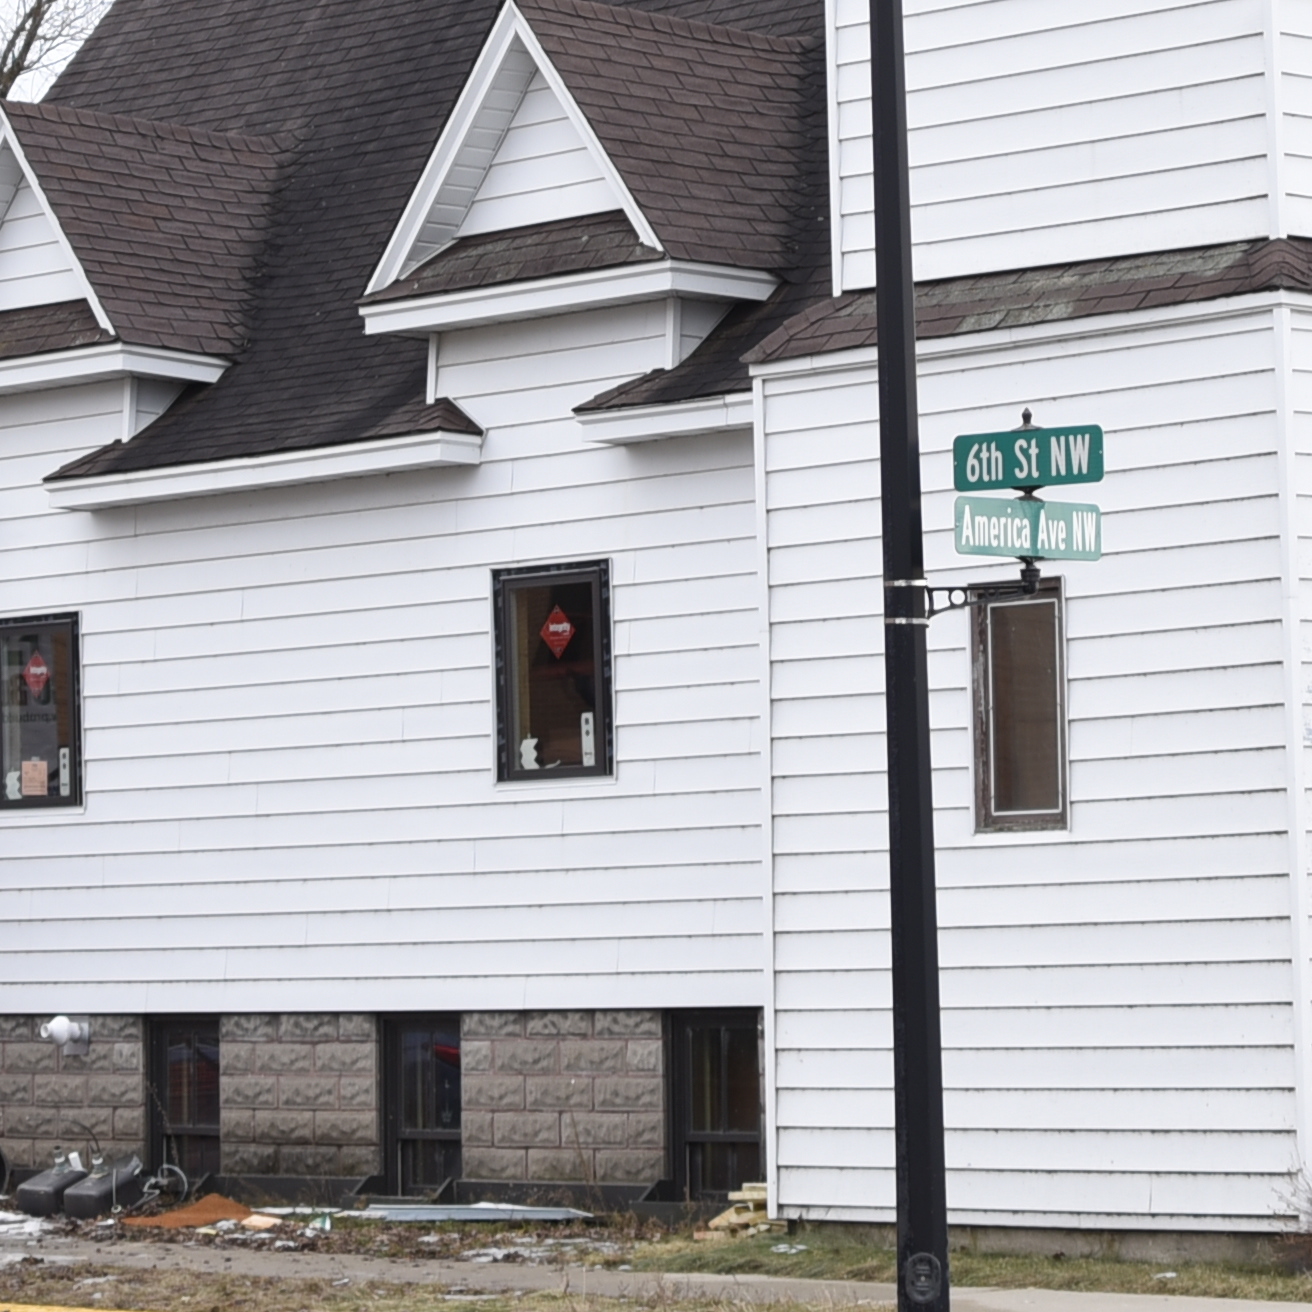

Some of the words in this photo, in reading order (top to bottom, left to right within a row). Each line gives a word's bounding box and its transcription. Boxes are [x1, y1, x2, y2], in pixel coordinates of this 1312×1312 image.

[966, 441, 1003, 483] 6th
[1014, 438, 1039, 479] St
[1050, 434, 1090, 477] NW
[961, 504, 1031, 549] America
[1037, 508, 1066, 551] Ave
[1072, 510, 1097, 553] NW
